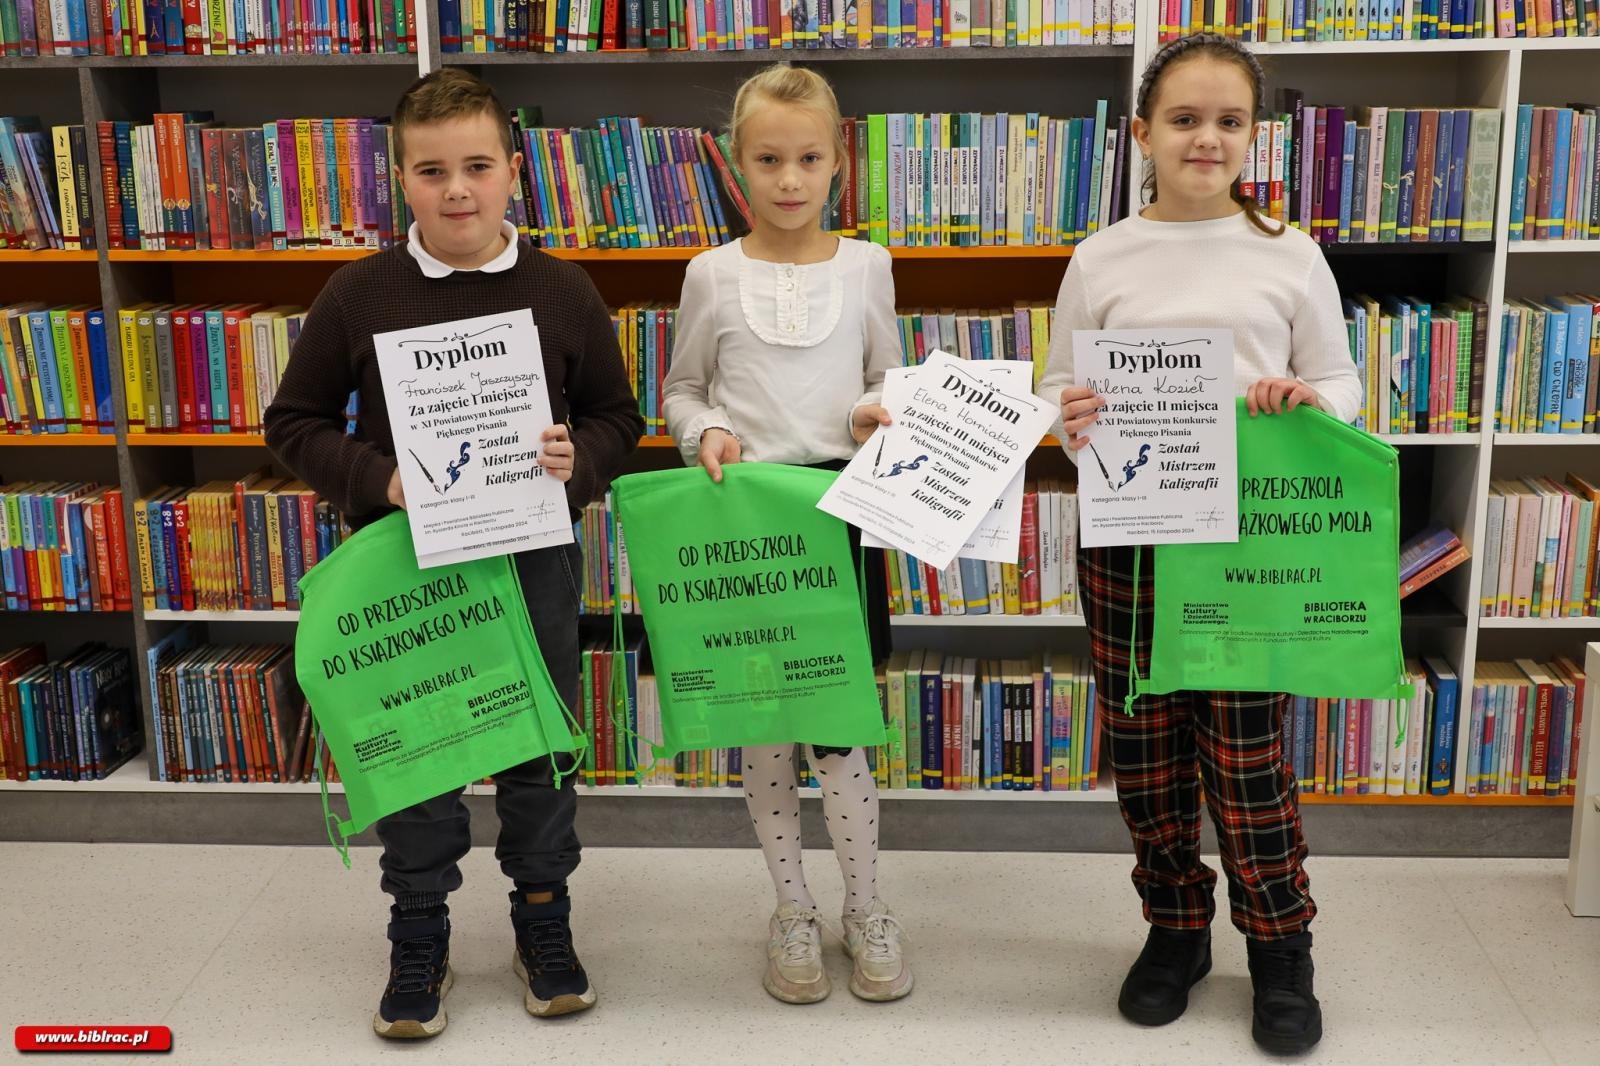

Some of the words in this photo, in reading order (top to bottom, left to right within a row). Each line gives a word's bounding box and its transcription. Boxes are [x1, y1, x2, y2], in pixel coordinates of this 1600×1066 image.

[78, 164, 87, 194] ZAGINIONY
[873, 160, 883, 193] Bratki
[414, 340, 507, 370] Dyplom
[1108, 349, 1202, 373] Dyplom
[399, 378, 465, 397] Franciszek
[1087, 378, 1143, 395] Milena
[409, 404, 425, 417] Za
[427, 397, 469, 414] zajęcie
[481, 389, 528, 405] miejsca
[913, 388, 948, 413] Elena
[942, 374, 1021, 425] Dyplom
[1095, 403, 1108, 413] Za
[1112, 402, 1154, 414] zajęcie
[1171, 402, 1218, 413] miejsca
[421, 420, 432, 429] XI
[433, 412, 487, 427] Powiatowym
[489, 402, 532, 417] Konkursie
[1117, 417, 1171, 426] Powiatowym
[1173, 417, 1217, 425] Konkursie
[436, 427, 475, 440] Pięknego
[477, 420, 507, 431] Pisania
[478, 431, 519, 450] Zostań
[902, 405, 917, 416] Za
[917, 409, 953, 435] zajęcie
[954, 427, 968, 442] III
[969, 435, 1010, 465] miejsca
[1120, 430, 1159, 438] Pięknego
[1161, 429, 1192, 437] Pisania
[482, 450, 538, 468] Mistrzem
[905, 422, 916, 431] XI
[914, 424, 960, 453] Powiatowym
[961, 448, 999, 472] Konkursie
[910, 435, 942, 458] Pięknego
[943, 452, 970, 470] Pisania
[1158, 442, 1200, 454] Zostań
[485, 467, 543, 486] Kaligrafii
[930, 461, 968, 487] Zostań
[1158, 461, 1216, 472] Mistrzem
[921, 476, 971, 507] Mistrzem
[1159, 477, 1219, 491] Kaligrafii
[1241, 476, 1344, 500] PRZEDSZKOLA
[911, 489, 965, 521] Kaligrafii
[162, 510, 172, 527] 8+2
[175, 509, 184, 527] 8+2
[1239, 509, 1323, 537] ĄŻKOWEGO
[1329, 511, 1372, 533] MOLA
[287, 528, 295, 547] GANG
[678, 546, 699, 567] OD
[705, 534, 807, 566] PRZEDSZKOLA
[659, 583, 678, 604] DO
[793, 565, 838, 590] MOLA
[1225, 567, 1322, 584] WWW.BIBLRAC.PL
[337, 612, 360, 637] OD
[363, 572, 469, 629] PRZEDSZKOLA
[1305, 601, 1367, 612] BIBLIOTEKA
[1304, 616, 1311, 624] W
[1313, 614, 1367, 623] RACIBORZU
[322, 654, 346, 680] DO
[459, 595, 505, 630] MOLA
[703, 625, 796, 649] WWW.BIBLRAC.PL
[783, 654, 845, 671] BIBLIOTEKA
[795, 667, 846, 680] RACIBORZU
[380, 663, 477, 711] WWW.BIBLRAC.PL
[672, 675, 704, 683] Kultury
[468, 680, 527, 709] BIBLIOTEKA
[472, 711, 481, 719] W
[481, 691, 530, 715] RACIBORZU
[1296, 715, 1304, 740] ZOSIA
[355, 738, 388, 753] Kultury
[1535, 741, 1544, 757] KELLY
[1534, 759, 1542, 773] YANG
